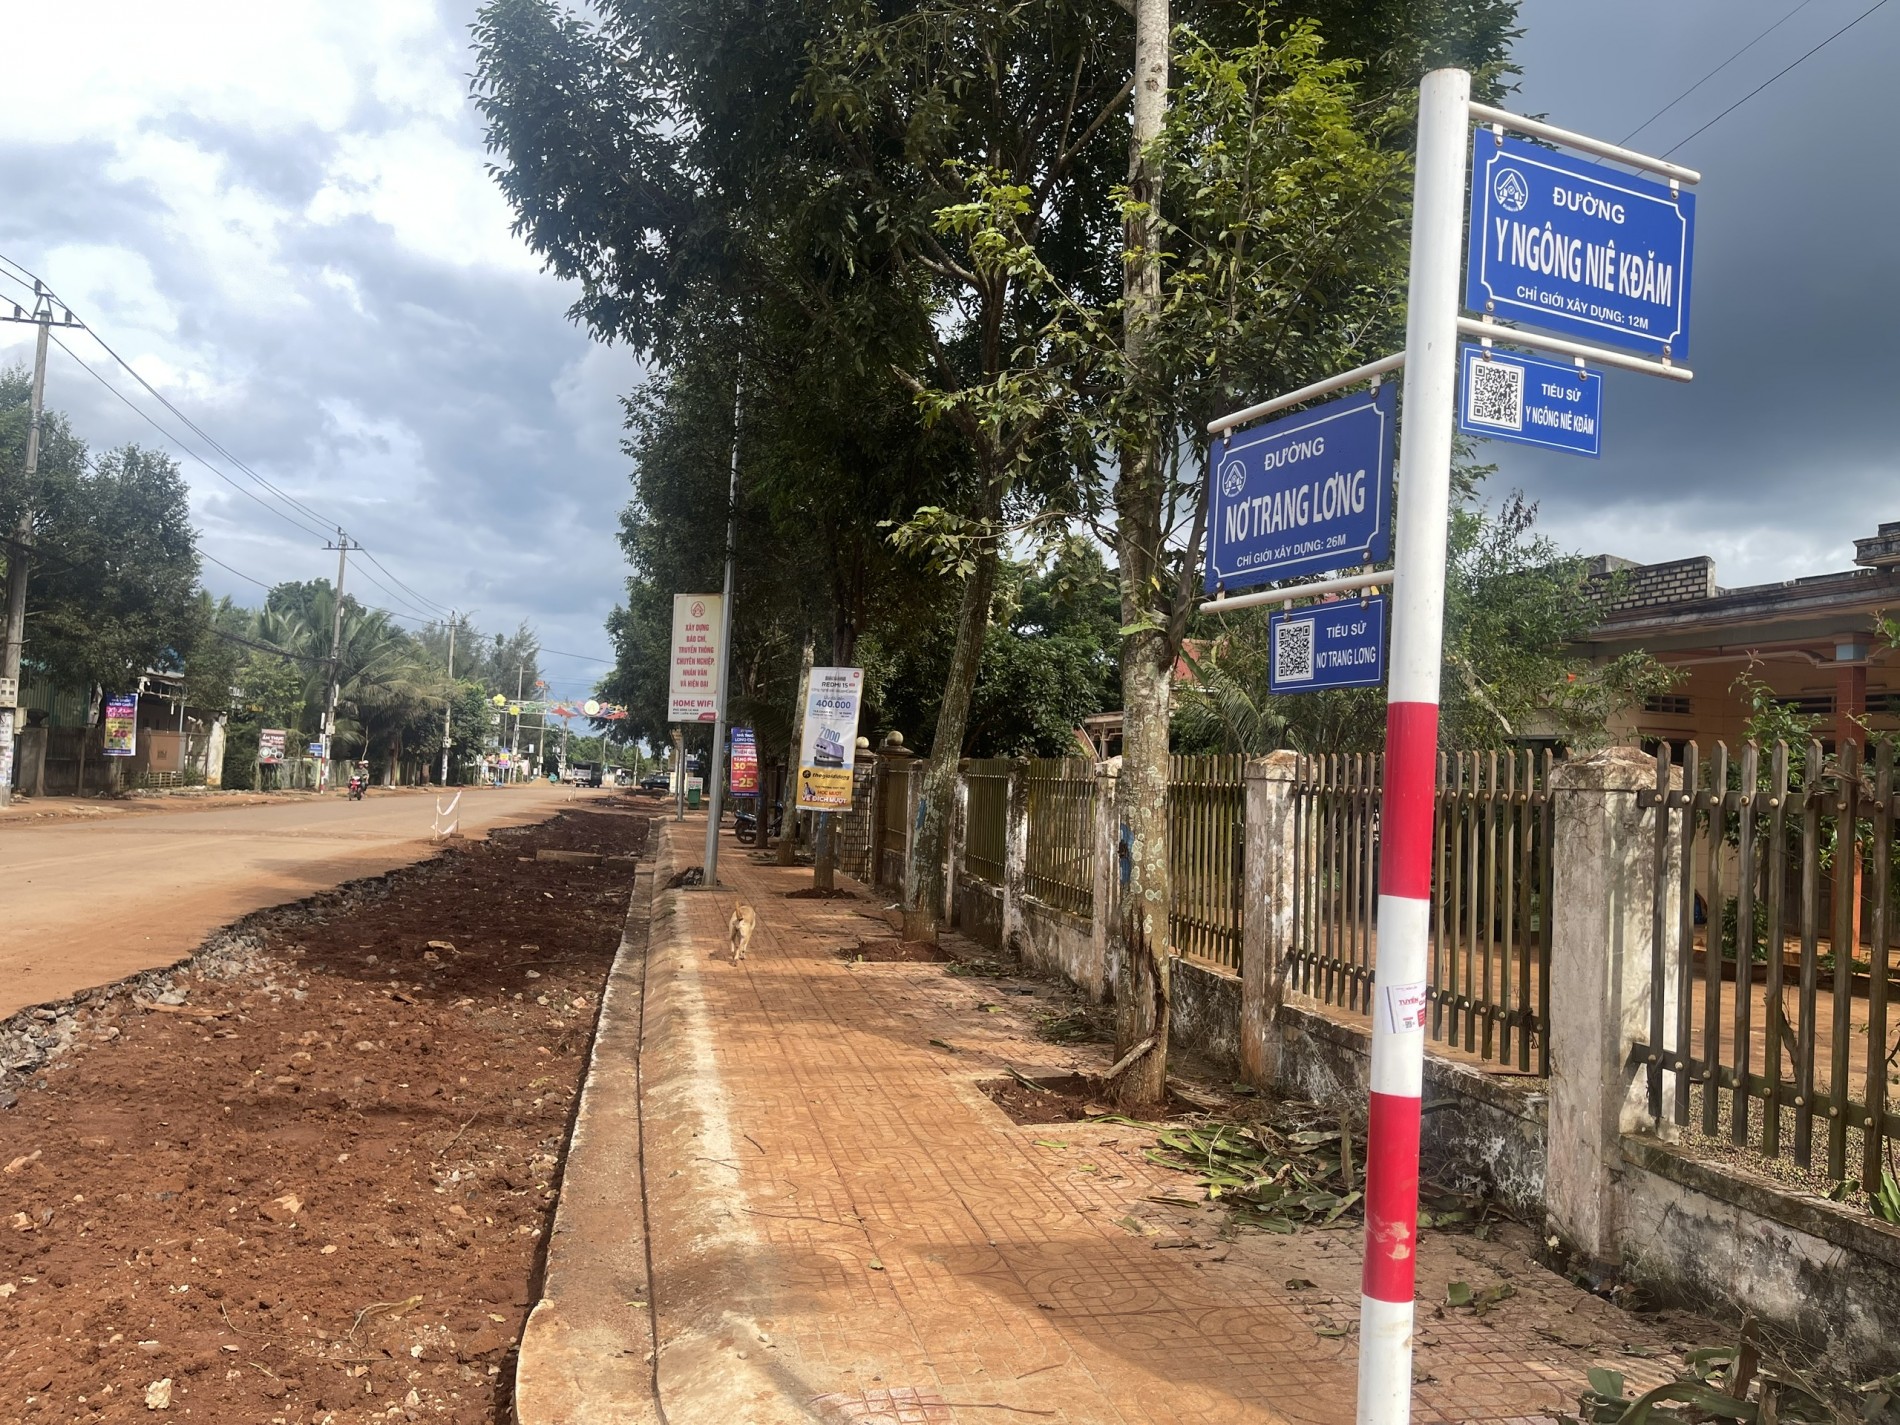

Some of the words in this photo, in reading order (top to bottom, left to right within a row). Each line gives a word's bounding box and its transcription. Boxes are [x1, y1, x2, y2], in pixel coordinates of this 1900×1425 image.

[1552, 187, 1625, 224] ĐƯỜNG
[1495, 217, 1509, 262] Y
[1511, 221, 1582, 283] NGÔNG
[1585, 239, 1615, 292] NIÊ
[1618, 250, 1673, 307] KĐĂM
[1516, 285, 1538, 301] CHỈ
[1539, 291, 1564, 308] GIỚI
[1566, 297, 1588, 314] XÂY
[1590, 304, 1626, 324] DỰNG:
[1627, 315, 1649, 330] 12M
[1541, 382, 1564, 399] TIỂU
[1565, 387, 1582, 402] SỬ
[1525, 405, 1532, 422] Y
[1532, 405, 1559, 428] NGÔNG
[1560, 410, 1572, 431] NIÊ
[1573, 413, 1594, 435] KĐĂM
[1264, 436, 1325, 471] ĐƯỜNG
[1225, 495, 1251, 545] NƠ
[1252, 484, 1309, 537] TRANG
[1313, 469, 1366, 523] LƠNG
[1236, 552, 1252, 568] CHỈ
[1253, 548, 1272, 563] GIỚI
[1274, 545, 1291, 559] XÂY
[1293, 540, 1324, 557] DỰNG:
[1326, 533, 1346, 549] 26M
[1326, 623, 1348, 639] TIỂU
[1350, 620, 1367, 635] SỬ
[1316, 651, 1327, 669] NƠ
[1328, 648, 1352, 667] TRANG
[816, 700, 851, 709] 400.000
